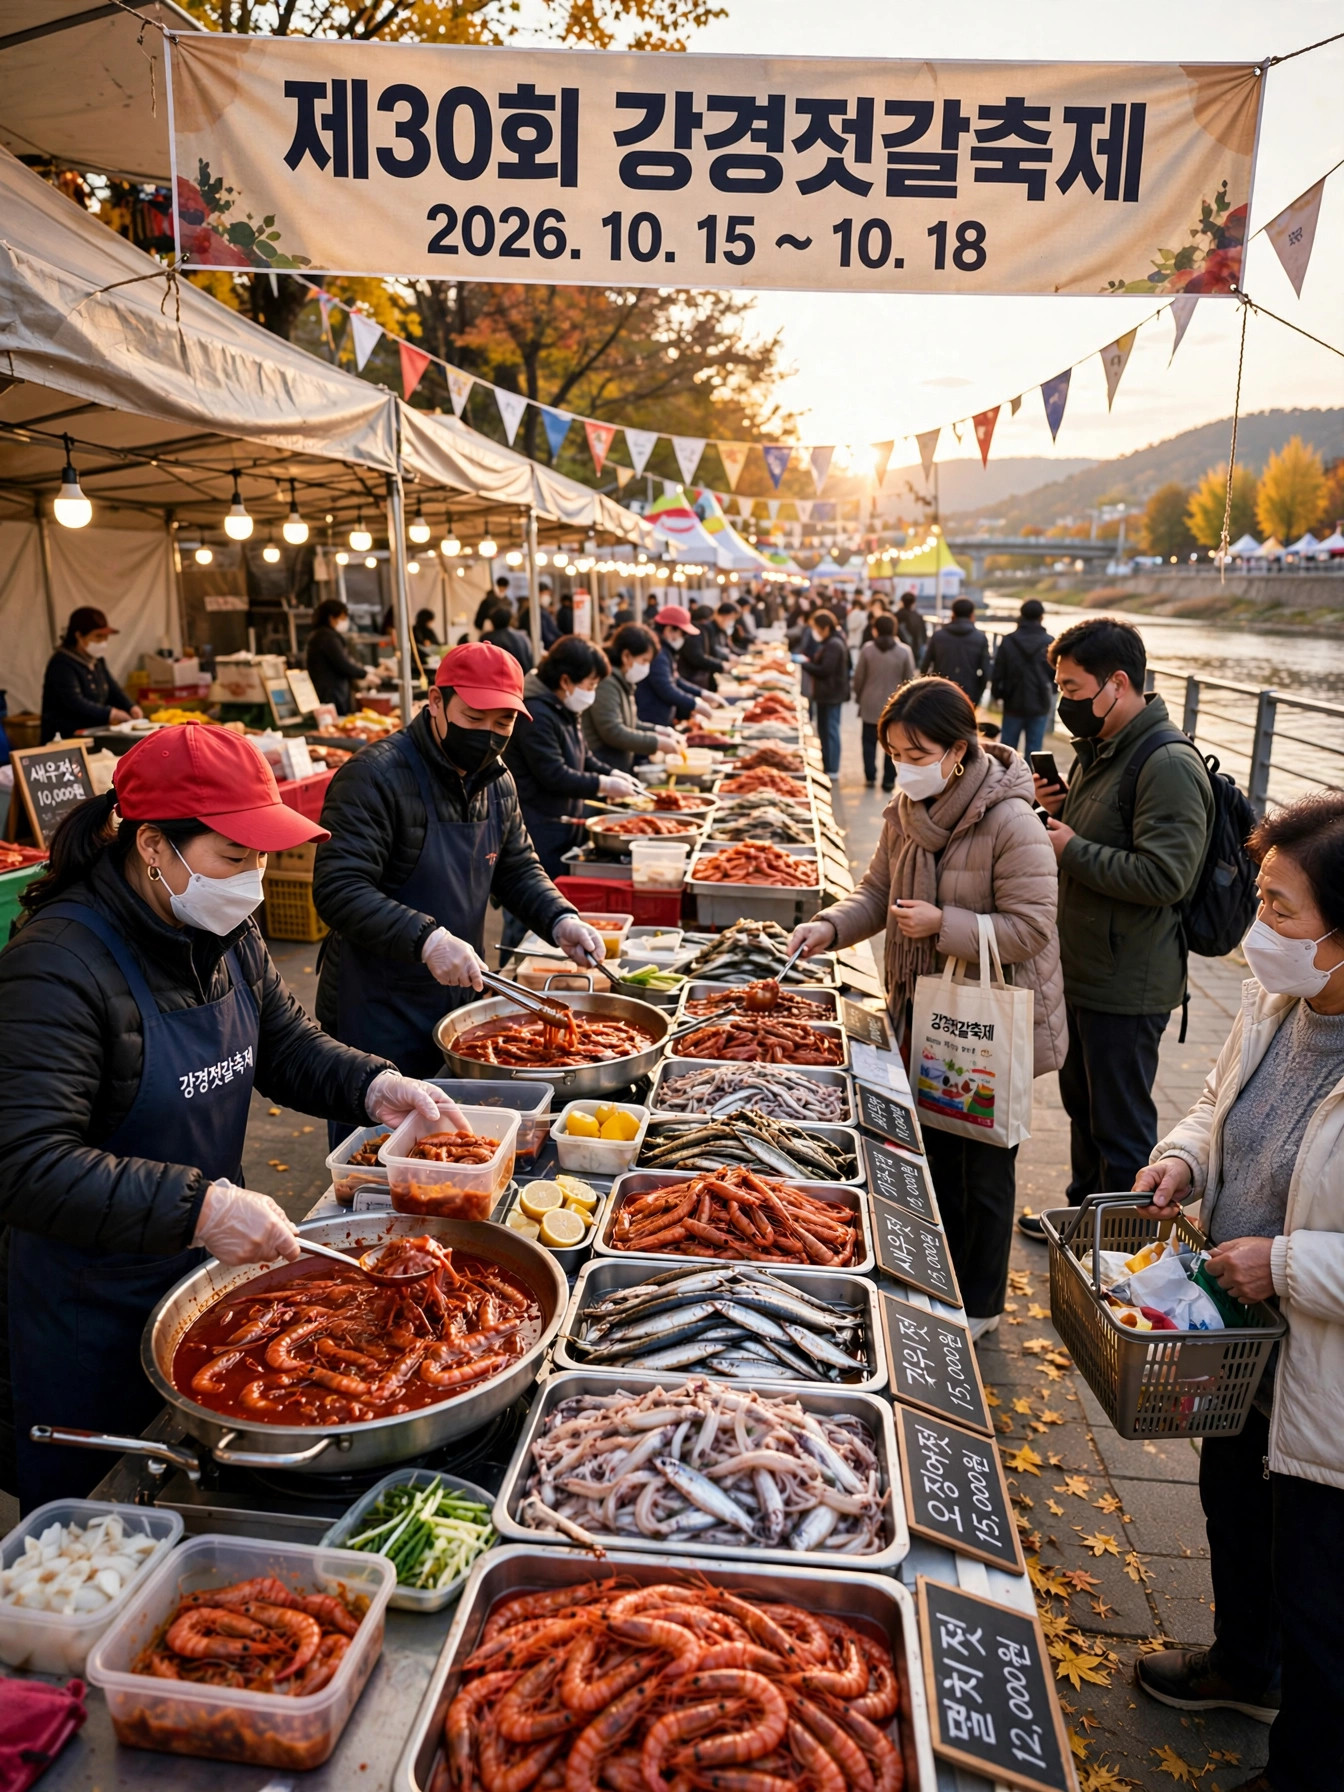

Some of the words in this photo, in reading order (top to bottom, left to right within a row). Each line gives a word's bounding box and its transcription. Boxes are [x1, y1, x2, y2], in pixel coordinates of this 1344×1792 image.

[283, 78, 580, 188] 제30회
[612, 90, 1147, 202] 강경젓갈축제
[426, 203, 581, 260] 2026.
[601, 210, 676, 263] 10.
[697, 215, 755, 265] 15
[832, 217, 905, 269] 10.
[926, 220, 987, 271] 18
[30, 757, 75, 783] 새우젓
[37, 783, 86, 807] 10,000원
[931, 1012, 994, 1041] 강경젓갈축제
[179, 1045, 253, 1098] 강경젓갈축제
[884, 1213, 916, 1275] 새우젓
[920, 1229, 948, 1290] 15,000원
[937, 1328, 974, 1410] 15,000원
[914, 1424, 963, 1533] 오징어젓
[962, 1449, 1002, 1547] 15,000원
[996, 1636, 1047, 1768] 12,000원
